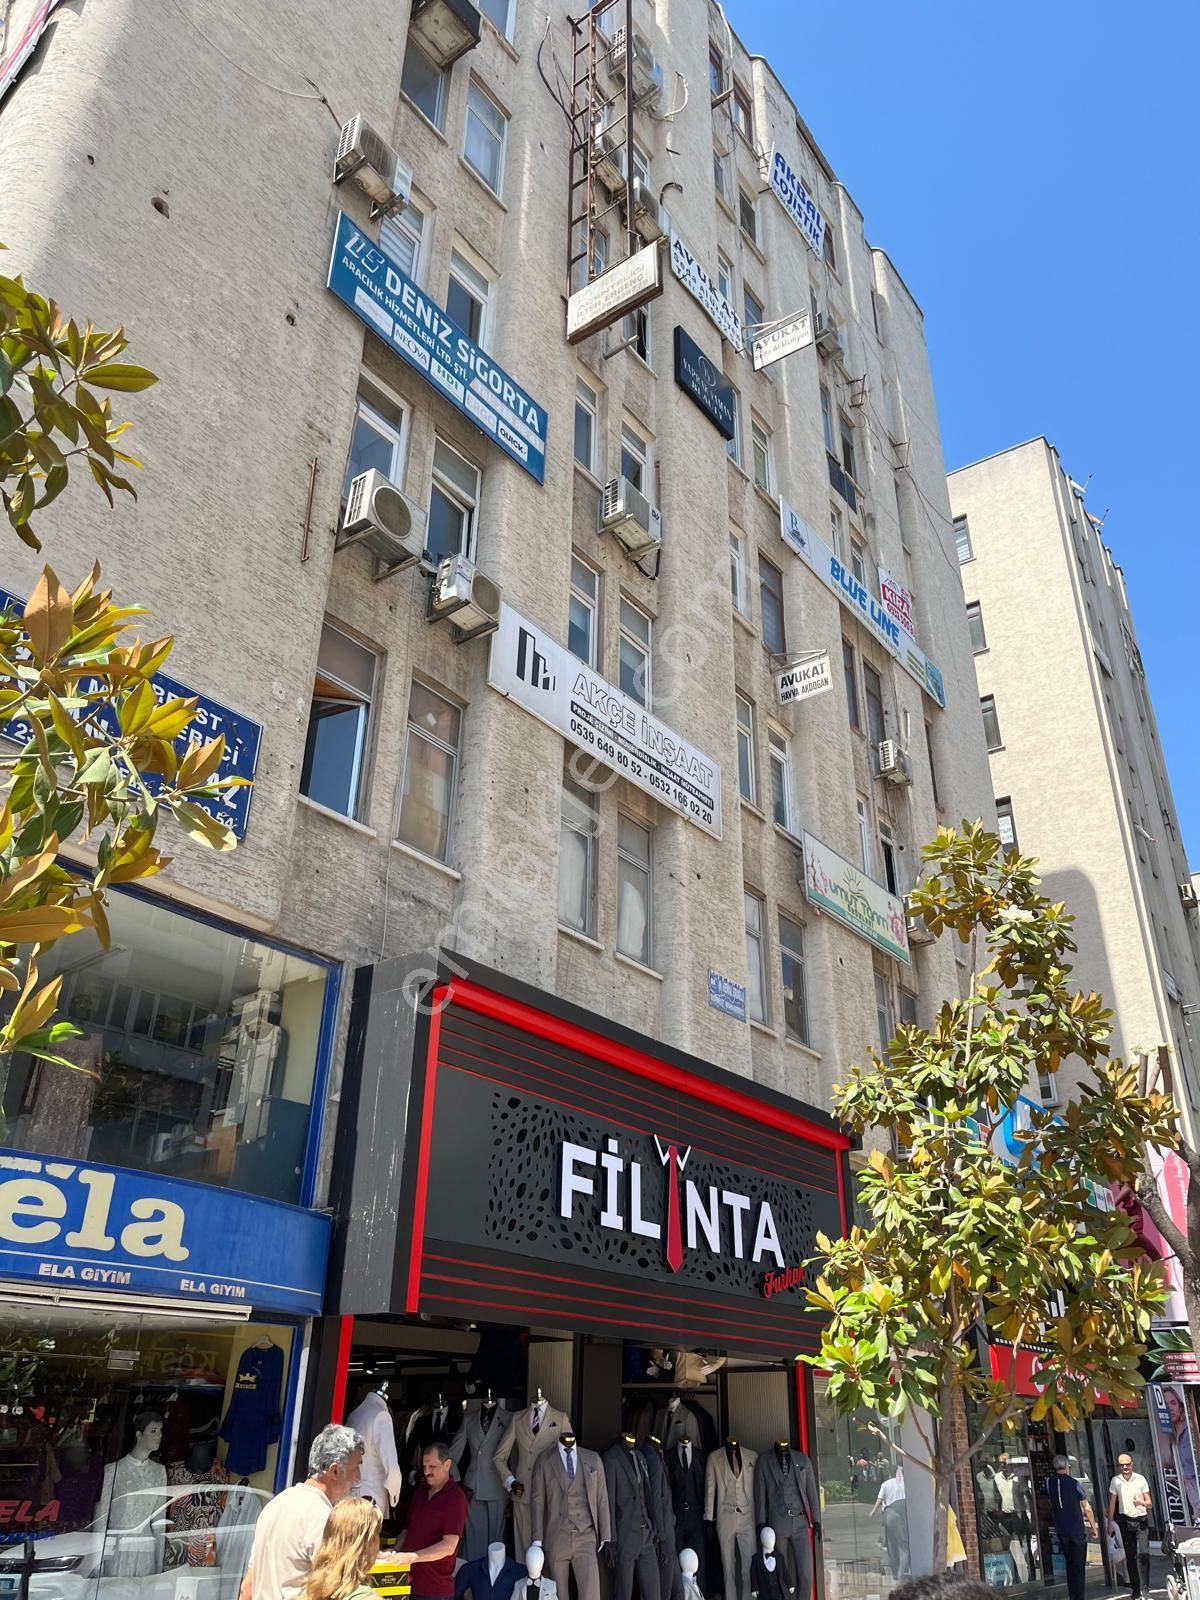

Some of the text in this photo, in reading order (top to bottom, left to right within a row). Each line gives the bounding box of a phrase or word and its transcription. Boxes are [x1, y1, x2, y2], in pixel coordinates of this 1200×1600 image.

[774, 151, 822, 232] AKBAL
[342, 256, 384, 299] ARACILIK
[673, 239, 740, 328] AVUKAT
[385, 266, 453, 348] DENİZ
[457, 339, 540, 434] SİGORTA
[755, 317, 807, 352] AVUKAT
[437, 365, 459, 390] HDI
[500, 427, 524, 454] QUICK
[830, 556, 867, 612] BLUE
[870, 599, 900, 647] LINE
[780, 661, 826, 689] AVUKAT
[780, 687, 800, 702] HAVVA
[572, 673, 713, 789] AKÇE İNŞAAT
[573, 703, 594, 725] PROJE
[570, 718, 594, 744] 0539
[597, 737, 614, 758] 649
[617, 751, 628, 768] 80
[631, 760, 642, 777] 52
[649, 773, 671, 795] 0532
[673, 788, 688, 807] 166
[690, 800, 700, 816] 02
[702, 808, 712, 825] 20
[38, 1263, 74, 1279] ELA
[179, 1278, 206, 1294] ELA
